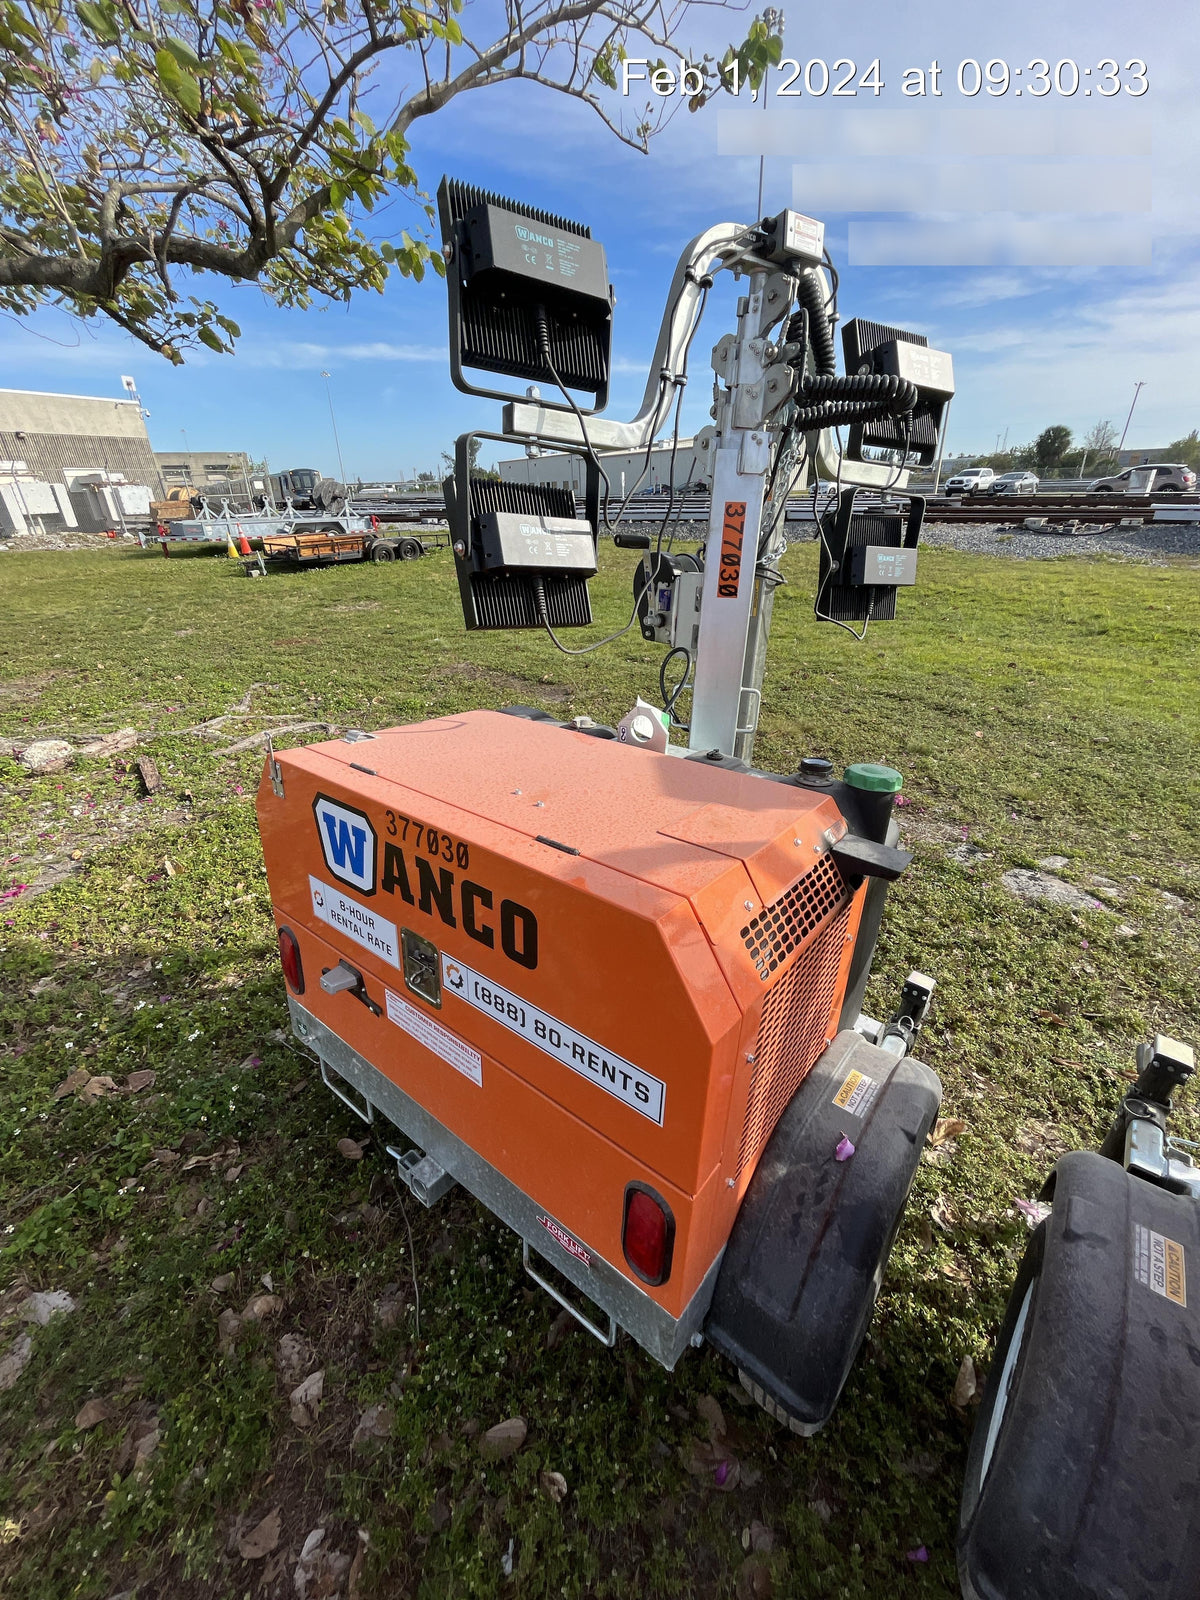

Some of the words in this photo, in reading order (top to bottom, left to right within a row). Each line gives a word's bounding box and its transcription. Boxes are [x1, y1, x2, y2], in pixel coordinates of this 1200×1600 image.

[515, 225, 554, 248] WANCO
[718, 503, 745, 597] 377030
[385, 810, 469, 870] 377030
[312, 792, 538, 970] WANCO
[331, 909, 365, 939] RENTAL
[367, 930, 393, 957] RATE
[339, 900, 375, 931] 8-HOUR
[404, 1004, 432, 1029] CUSTOMER
[433, 1024, 481, 1062] RESPONSIBILITY
[474, 981, 526, 1028] (888)
[534, 1018, 650, 1104] 80-RENTS
[840, 1073, 860, 1099] CAUTION
[847, 1094, 858, 1108] NOT
[856, 1079, 868, 1093] STEP
[1153, 1238, 1165, 1258] NOT
[1153, 1261, 1165, 1288] STEP
[1168, 1252, 1182, 1298] CAUTION
